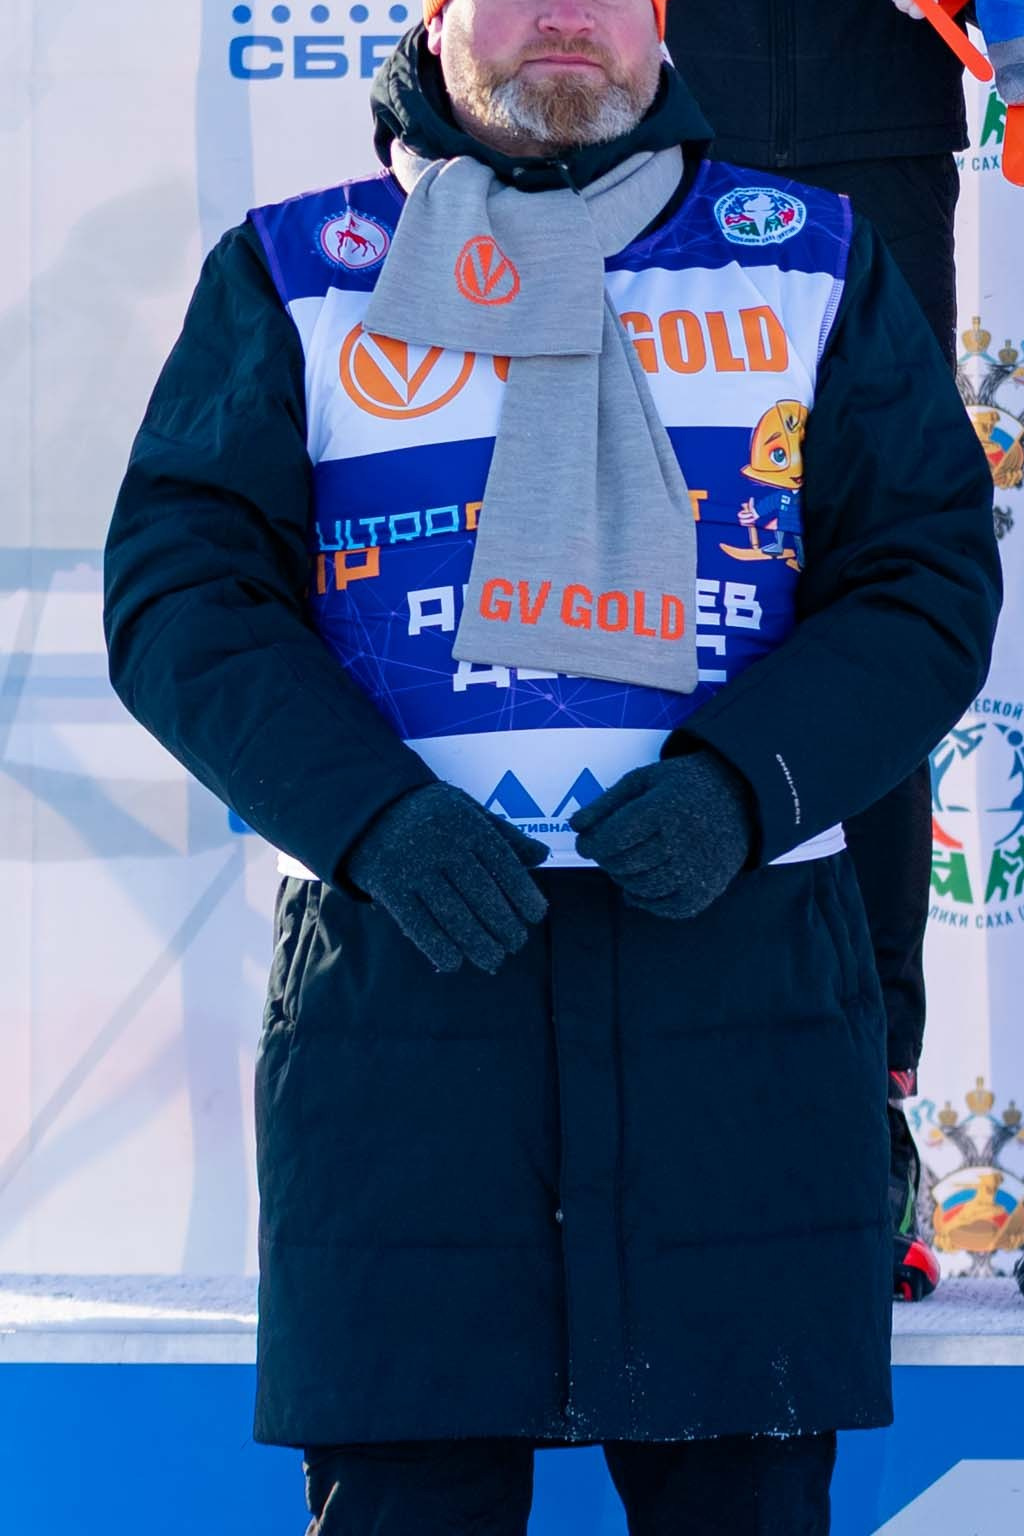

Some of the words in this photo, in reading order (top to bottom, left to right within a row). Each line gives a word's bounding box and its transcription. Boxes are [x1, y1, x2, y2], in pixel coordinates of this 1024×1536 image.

[479, 578, 552, 624] GV
[560, 583, 685, 640] GOLD
[970, 698, 1024, 720] ЕСКОЙ
[976, 911, 1014, 929] САХА
